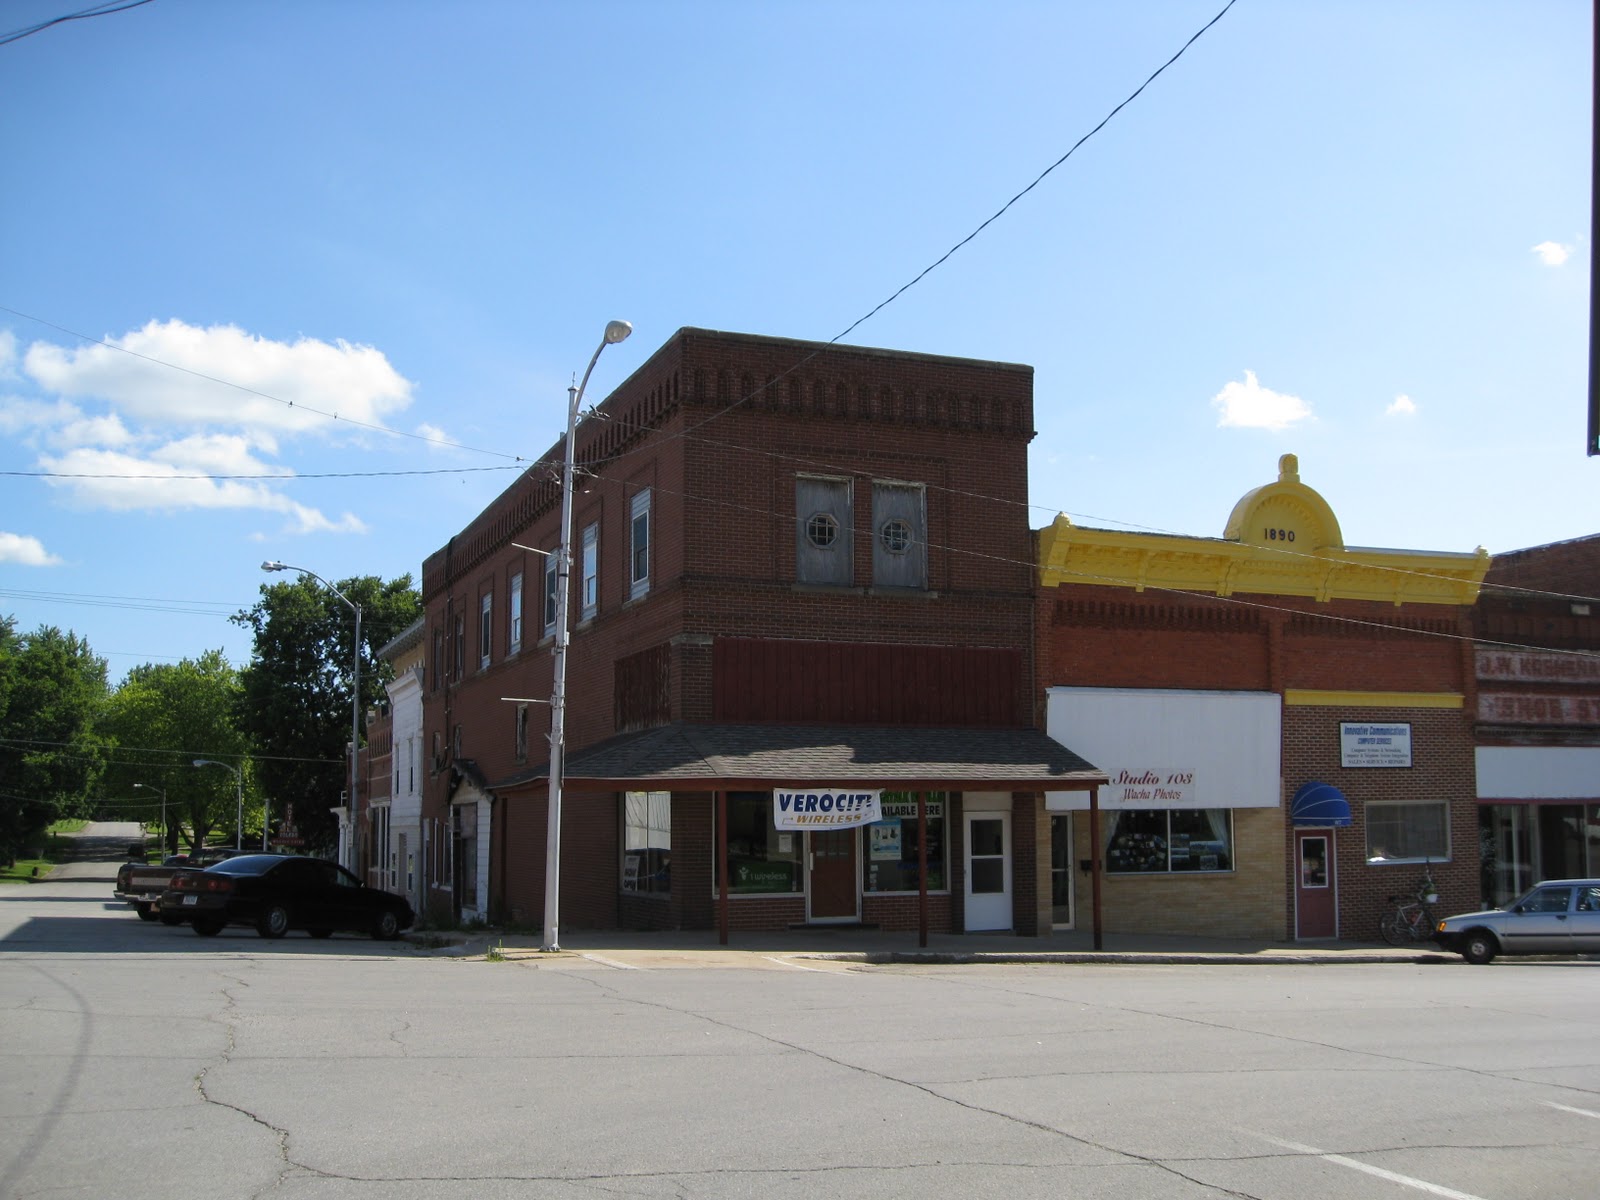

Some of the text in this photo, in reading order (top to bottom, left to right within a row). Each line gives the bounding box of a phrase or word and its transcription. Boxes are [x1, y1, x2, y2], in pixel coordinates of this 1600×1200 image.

[1264, 528, 1295, 542] 1890
[1344, 726, 1407, 736] Innovative Communications
[1113, 770, 1193, 785] Studio 103
[1153, 788, 1182, 800] Photos
[881, 805, 940, 817] AILABLE ERE
[796, 813, 862, 824] WIRELESS
[755, 872, 787, 880] wireless
